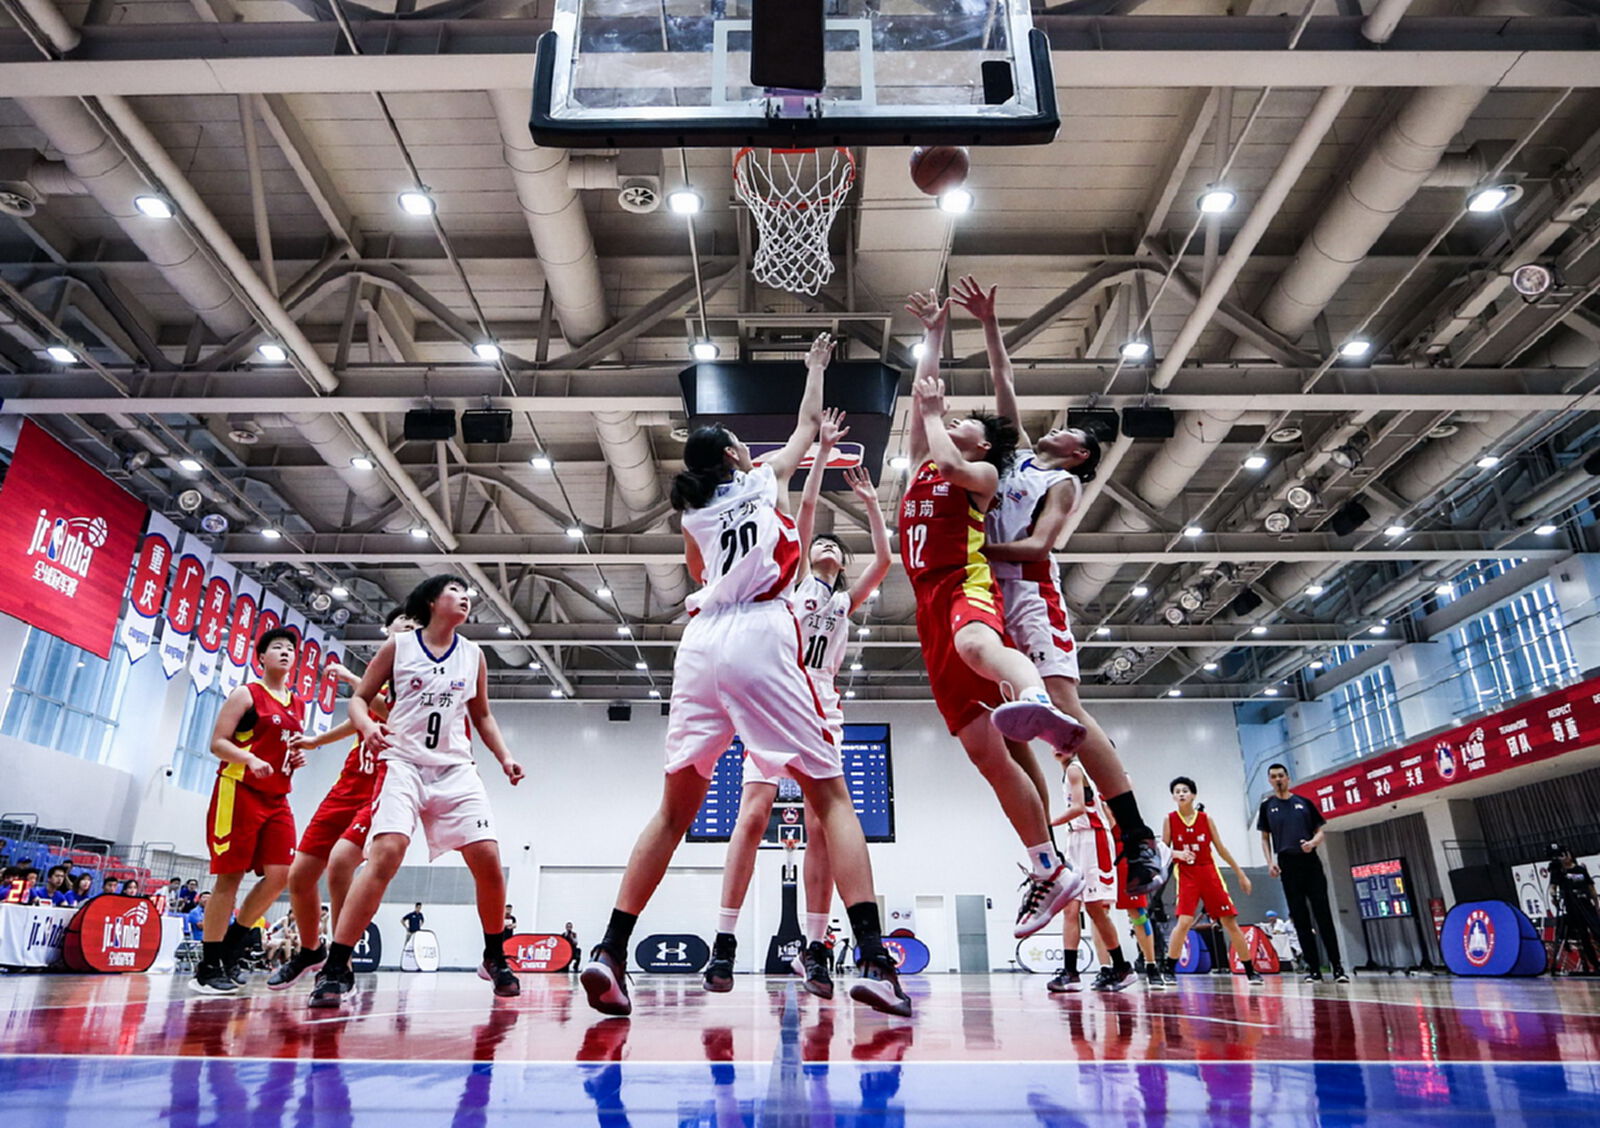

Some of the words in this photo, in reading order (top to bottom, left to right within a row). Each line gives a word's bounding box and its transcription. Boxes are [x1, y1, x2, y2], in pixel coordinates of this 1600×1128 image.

[903, 499, 935, 518] 湖南
[26, 508, 51, 556] jr.
[60, 531, 94, 578] nba
[720, 521, 758, 577] 20
[906, 524, 928, 569] 12
[139, 544, 165, 611] 重庆
[174, 565, 199, 626] 广东
[204, 584, 226, 645] 河北
[808, 612, 836, 632] 江苏
[303, 646, 318, 696] 辽宁
[804, 634, 829, 669] 10
[420, 692, 454, 708] 江苏
[425, 712, 442, 750] 9
[27, 915, 41, 951] jr.
[101, 915, 114, 953] jr.
[122, 918, 141, 949] nba
